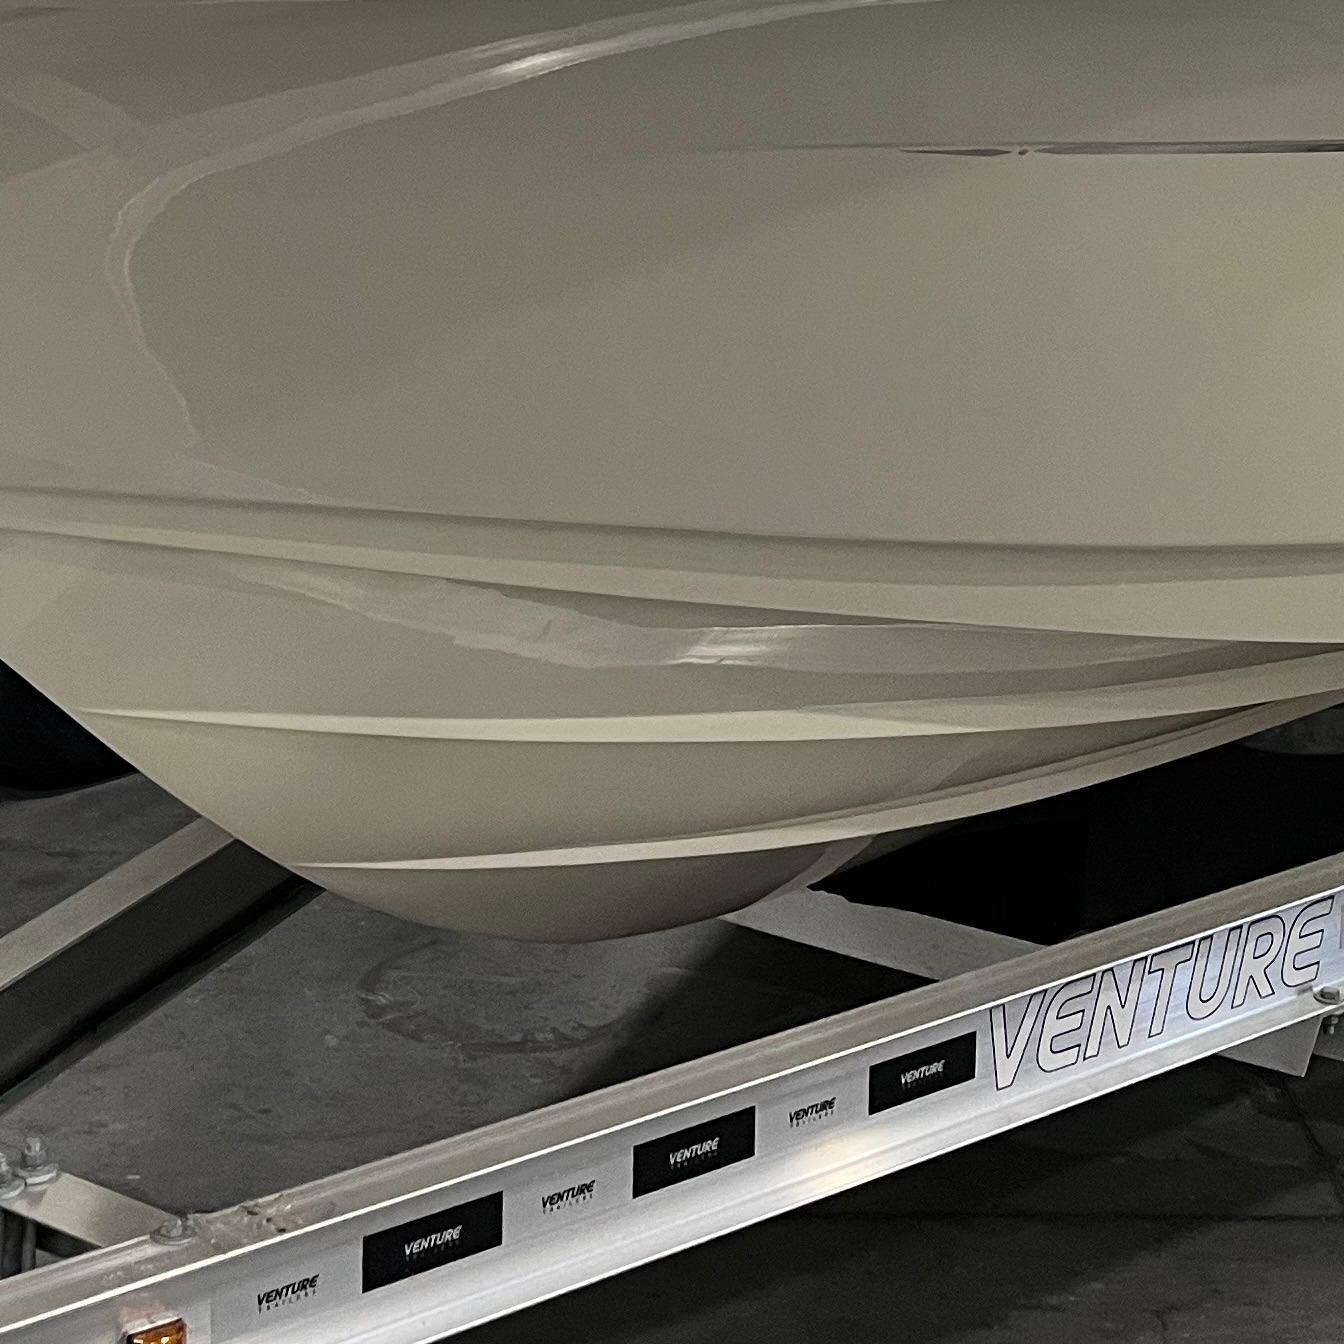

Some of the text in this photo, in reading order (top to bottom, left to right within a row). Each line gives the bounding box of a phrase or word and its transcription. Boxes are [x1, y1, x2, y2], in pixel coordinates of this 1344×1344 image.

[989, 895, 1335, 1091] VENTURE
[900, 1059, 946, 1085] VENTURE
[788, 1096, 837, 1123] VENTURE
[669, 1137, 720, 1166] VENTURE
[541, 1179, 596, 1209] VENTURE
[405, 1224, 463, 1256] VENTURE
[257, 1273, 320, 1307] VENTURE
